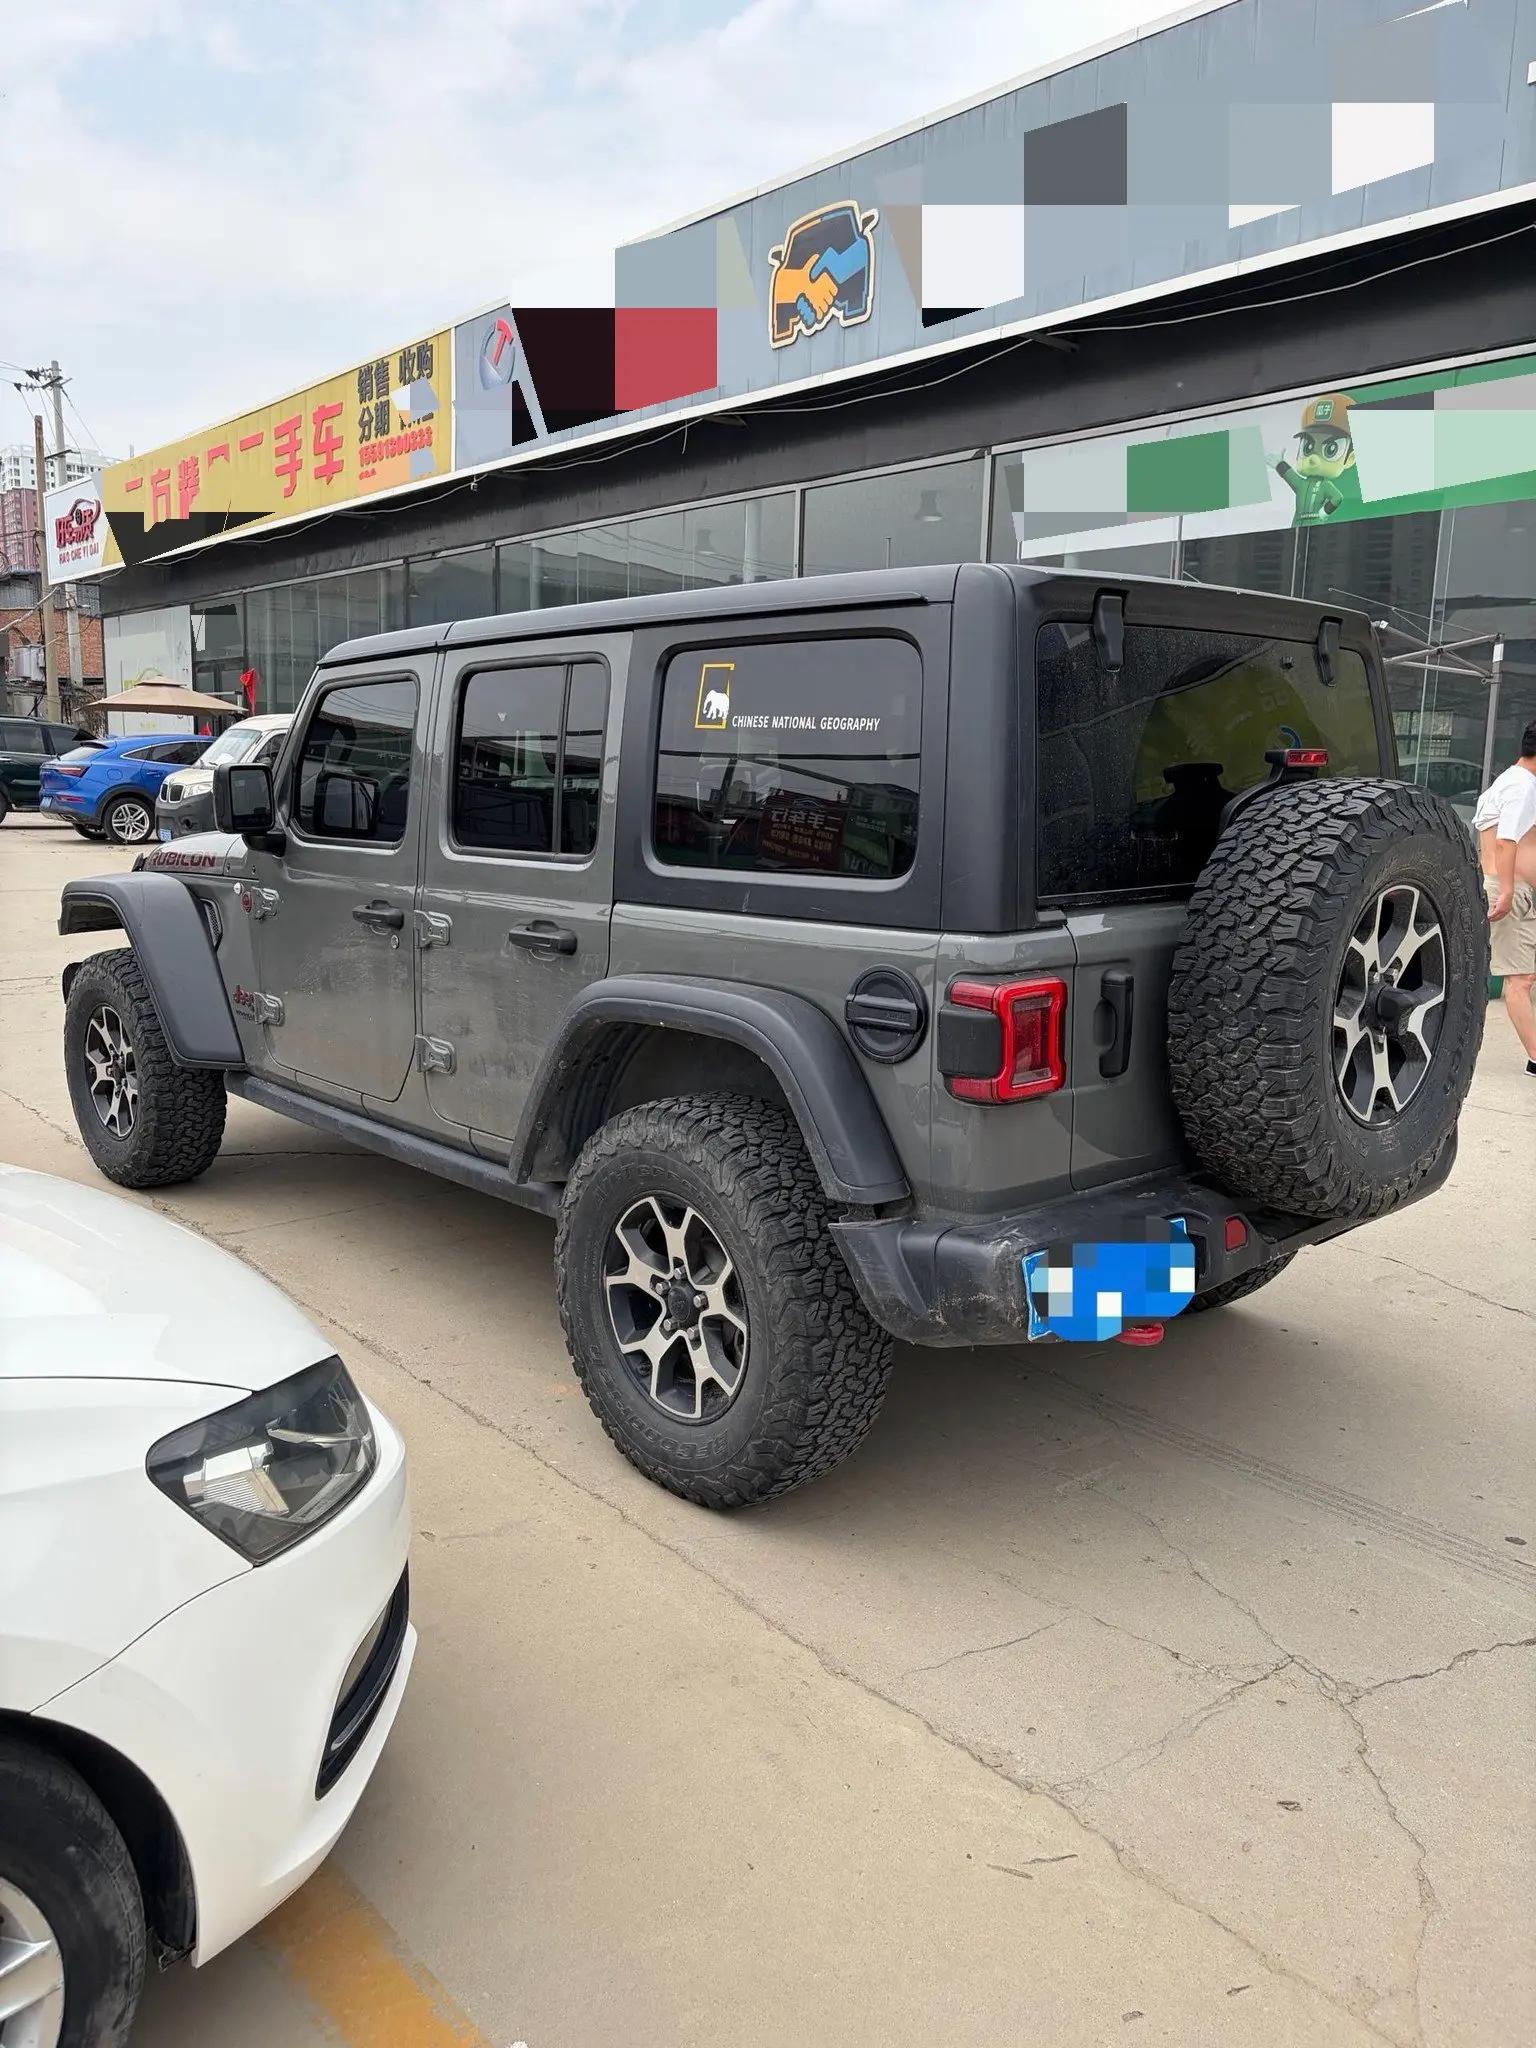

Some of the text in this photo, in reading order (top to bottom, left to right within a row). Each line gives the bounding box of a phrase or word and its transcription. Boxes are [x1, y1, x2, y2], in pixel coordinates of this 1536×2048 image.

[358, 342, 433, 404] 销售 收购
[358, 399, 390, 444] 分期
[732, 715, 880, 731] CHINESE NATIONAL GEOGRAPHY
[151, 851, 217, 868] RUBICON
